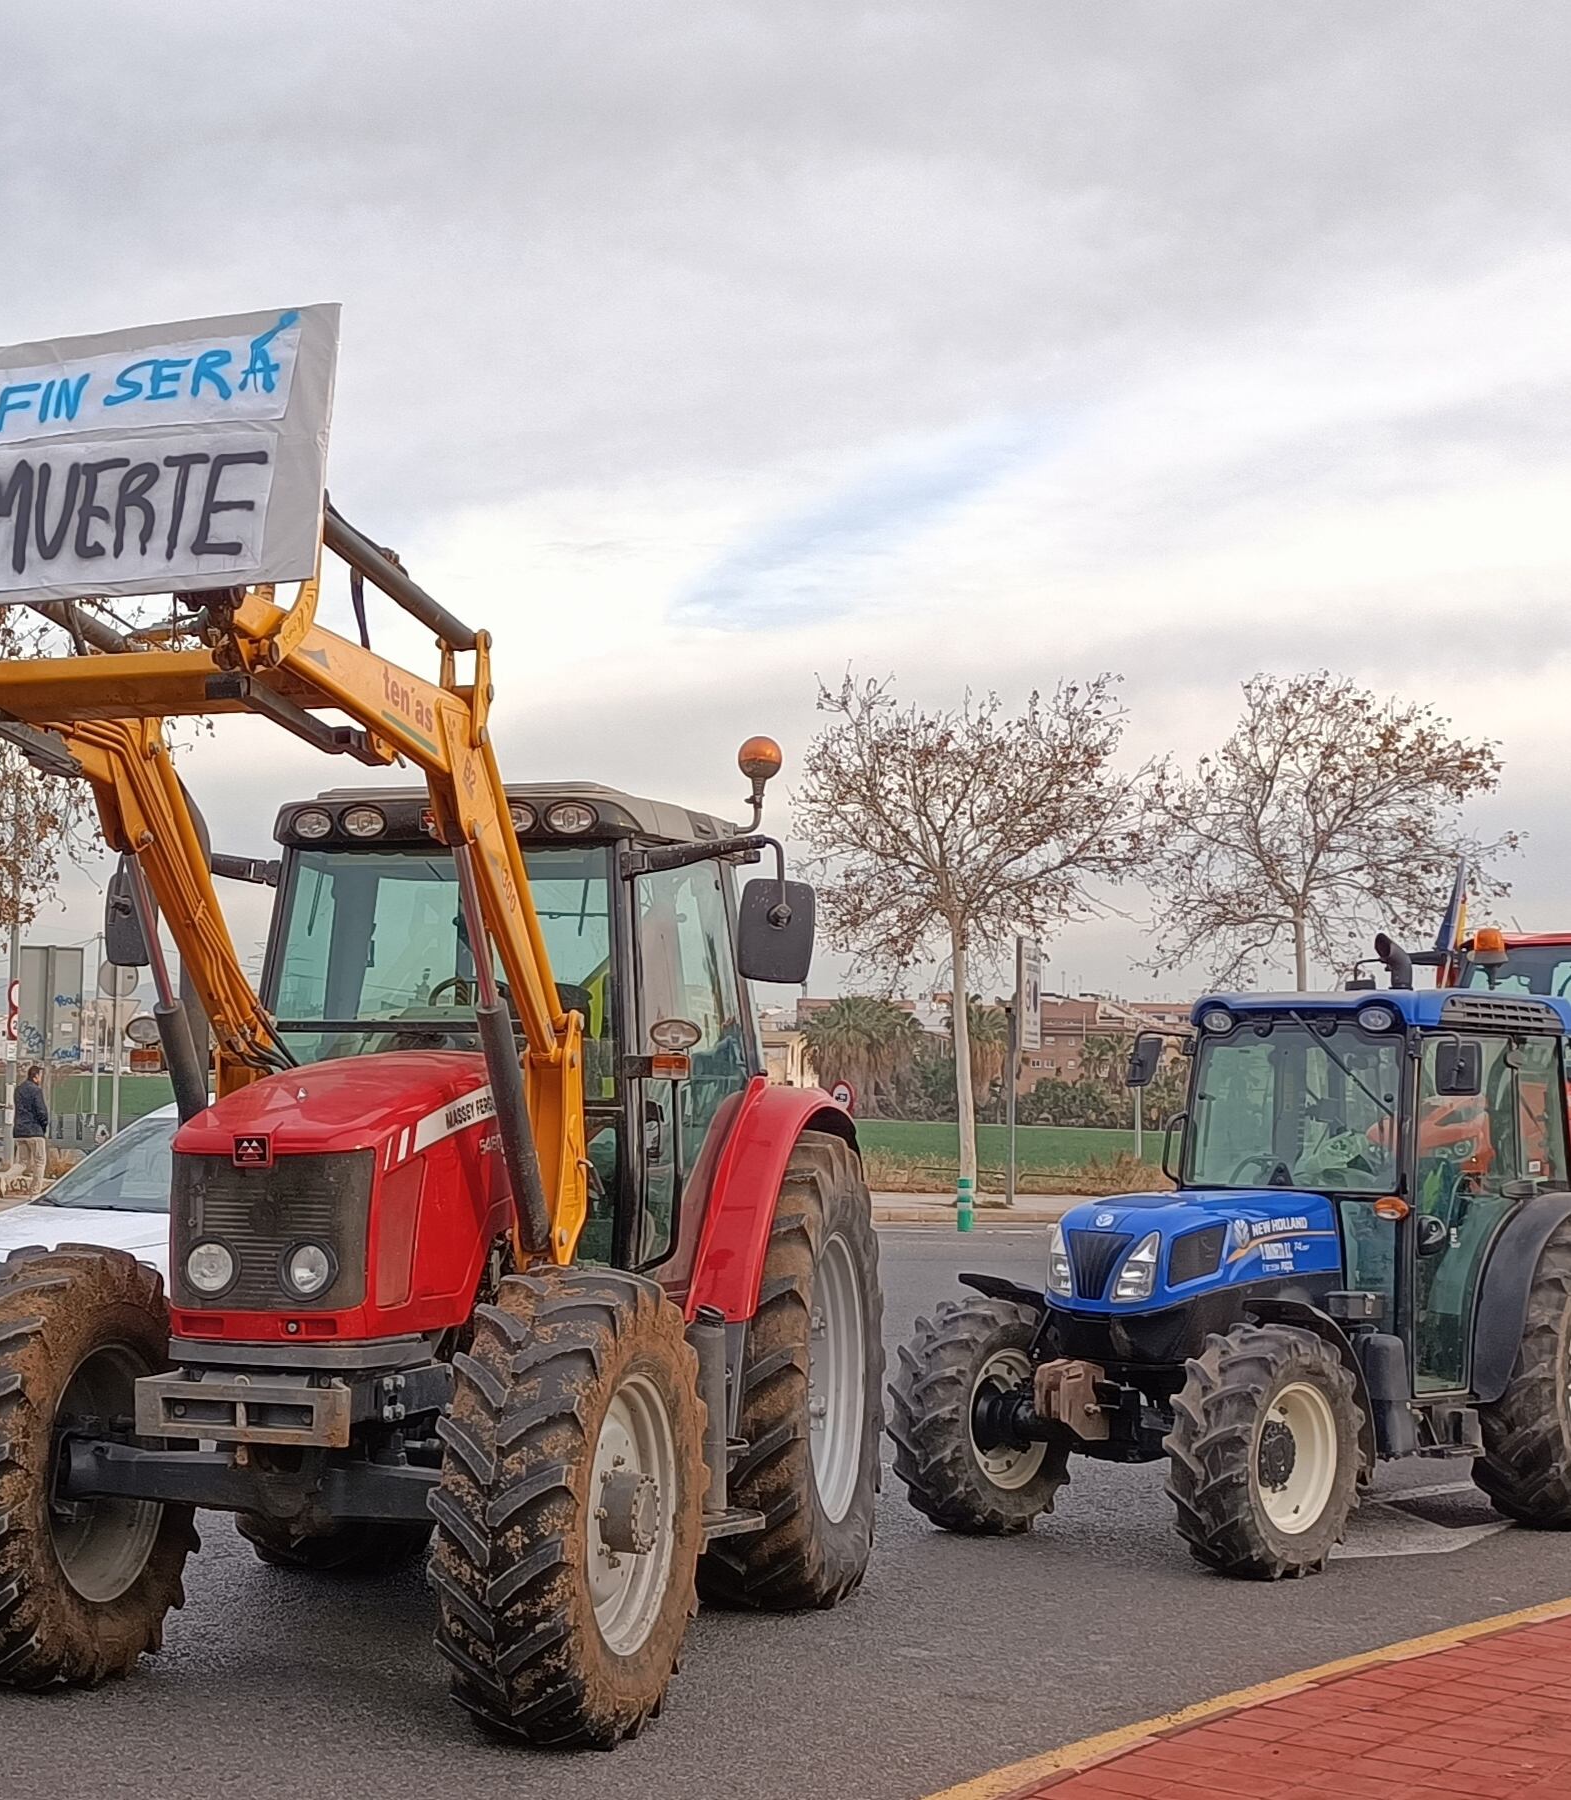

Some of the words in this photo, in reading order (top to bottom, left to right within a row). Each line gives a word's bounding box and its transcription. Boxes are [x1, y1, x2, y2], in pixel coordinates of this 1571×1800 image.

[103, 310, 301, 406] SERÁ
[445, 1101, 474, 1130] MASSEY
[1252, 1219, 1270, 1237] NEW
[1271, 1216, 1307, 1232] HOLLAND
